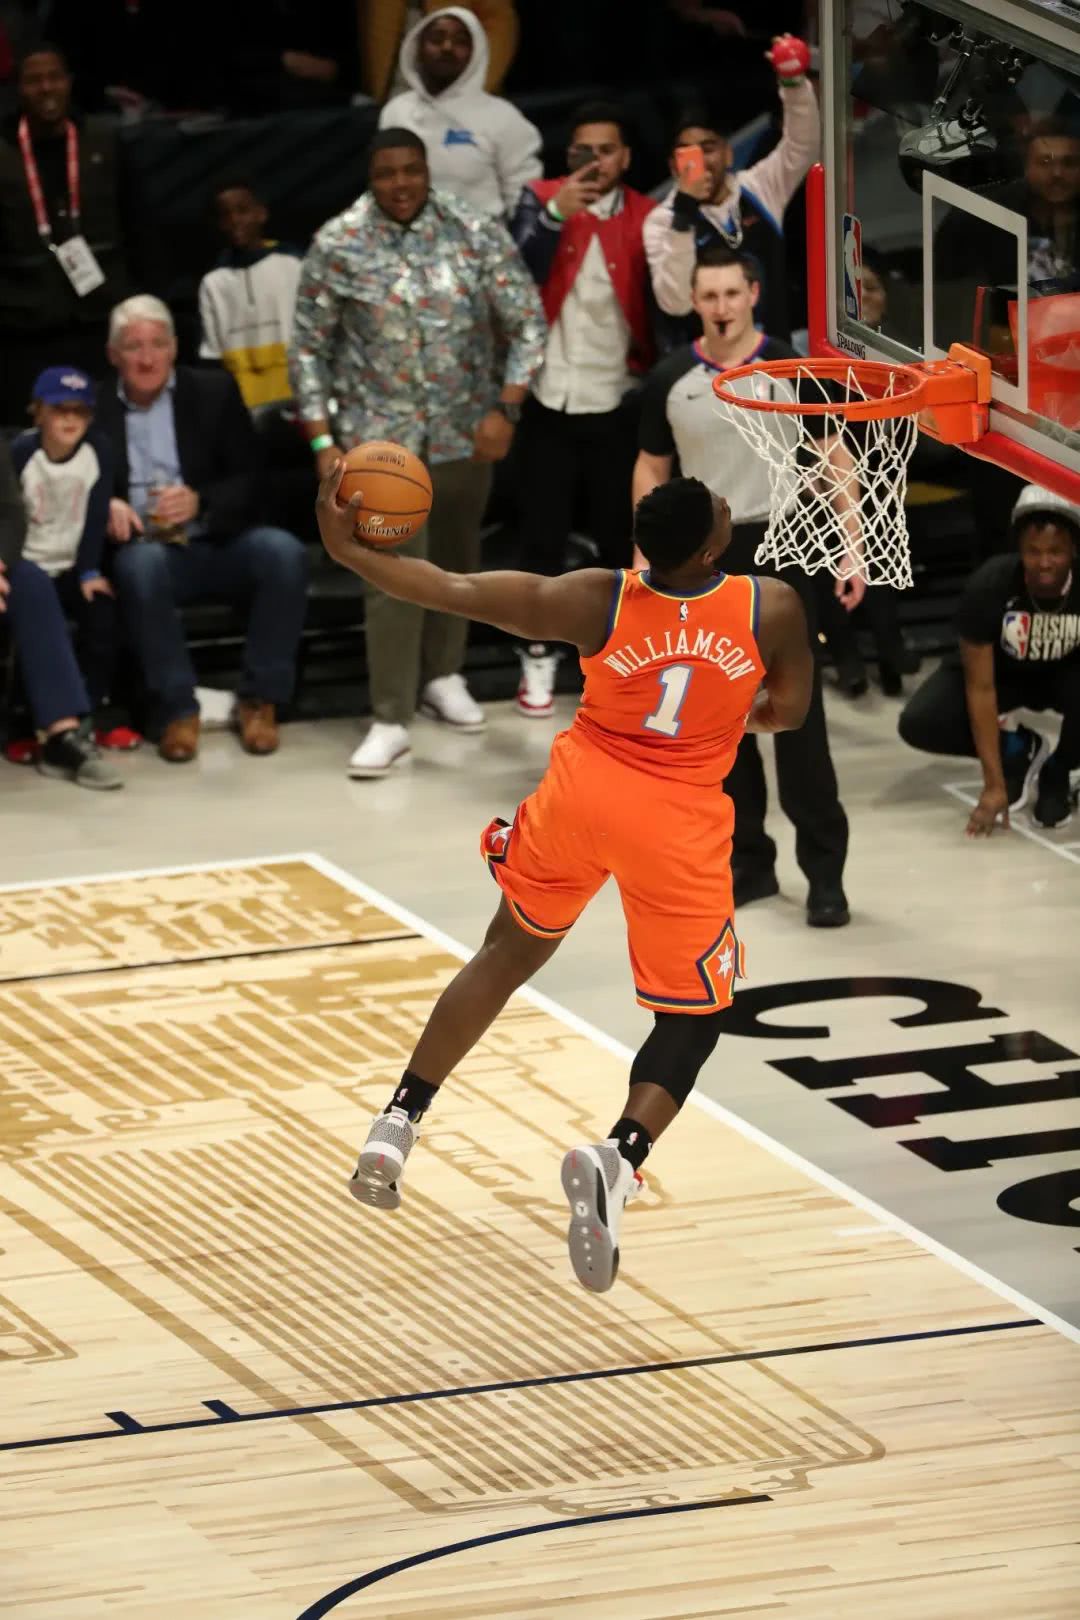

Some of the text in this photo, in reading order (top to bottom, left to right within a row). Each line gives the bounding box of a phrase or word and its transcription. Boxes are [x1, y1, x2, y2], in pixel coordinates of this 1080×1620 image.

[837, 332, 866, 361] SPALDING
[603, 628, 756, 681] WILLIAMSON
[642, 664, 694, 738] 1
[718, 976, 1080, 1228] CHI
